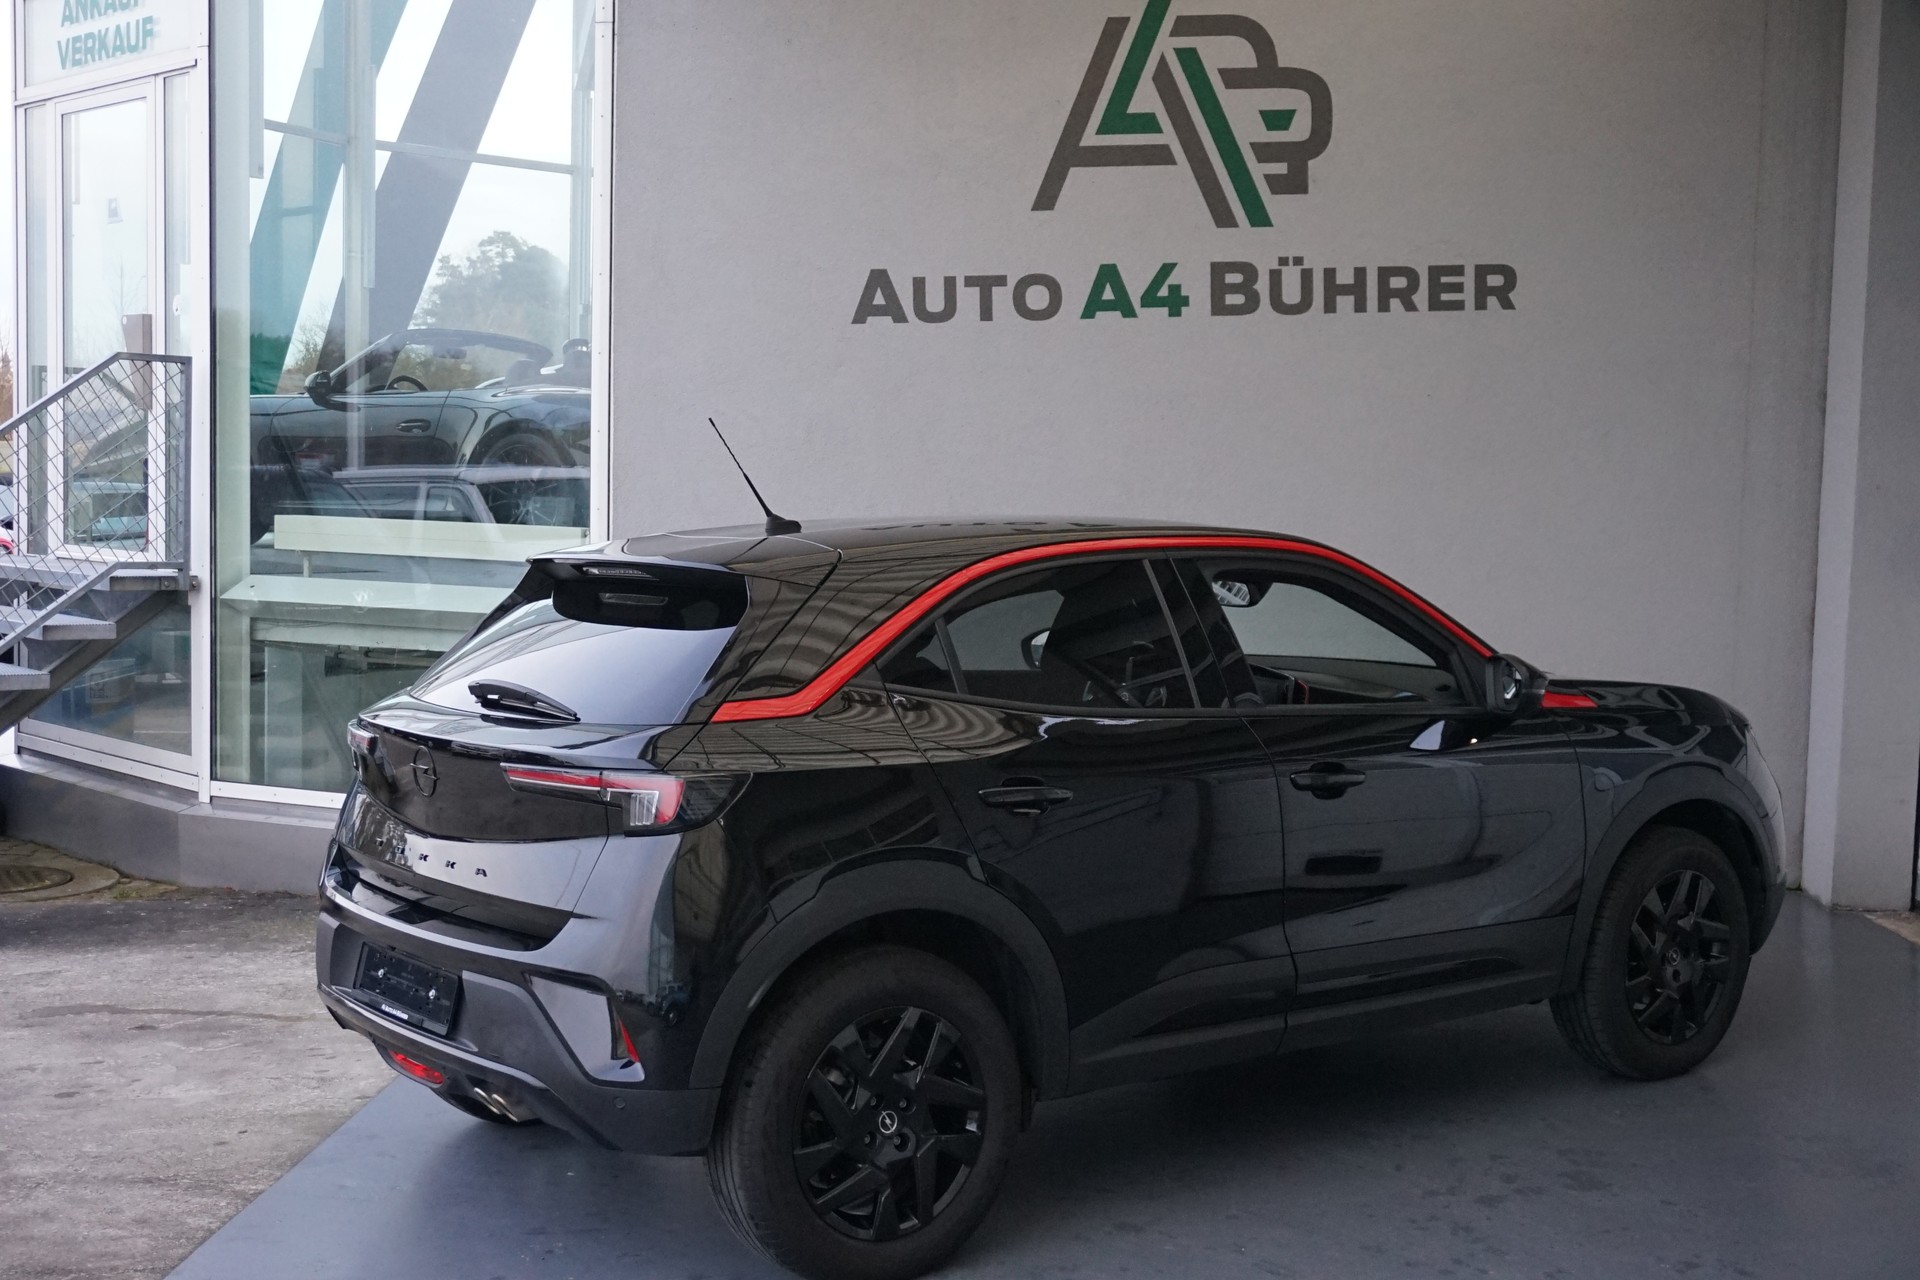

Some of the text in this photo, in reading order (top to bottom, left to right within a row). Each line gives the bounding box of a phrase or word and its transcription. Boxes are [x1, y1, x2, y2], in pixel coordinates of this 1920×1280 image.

[61, 0, 139, 28] ANKA
[57, 15, 154, 70] VERKAUF
[851, 256, 1518, 325] AUTO A4 BÜHRER
[374, 837, 488, 878] KKA
